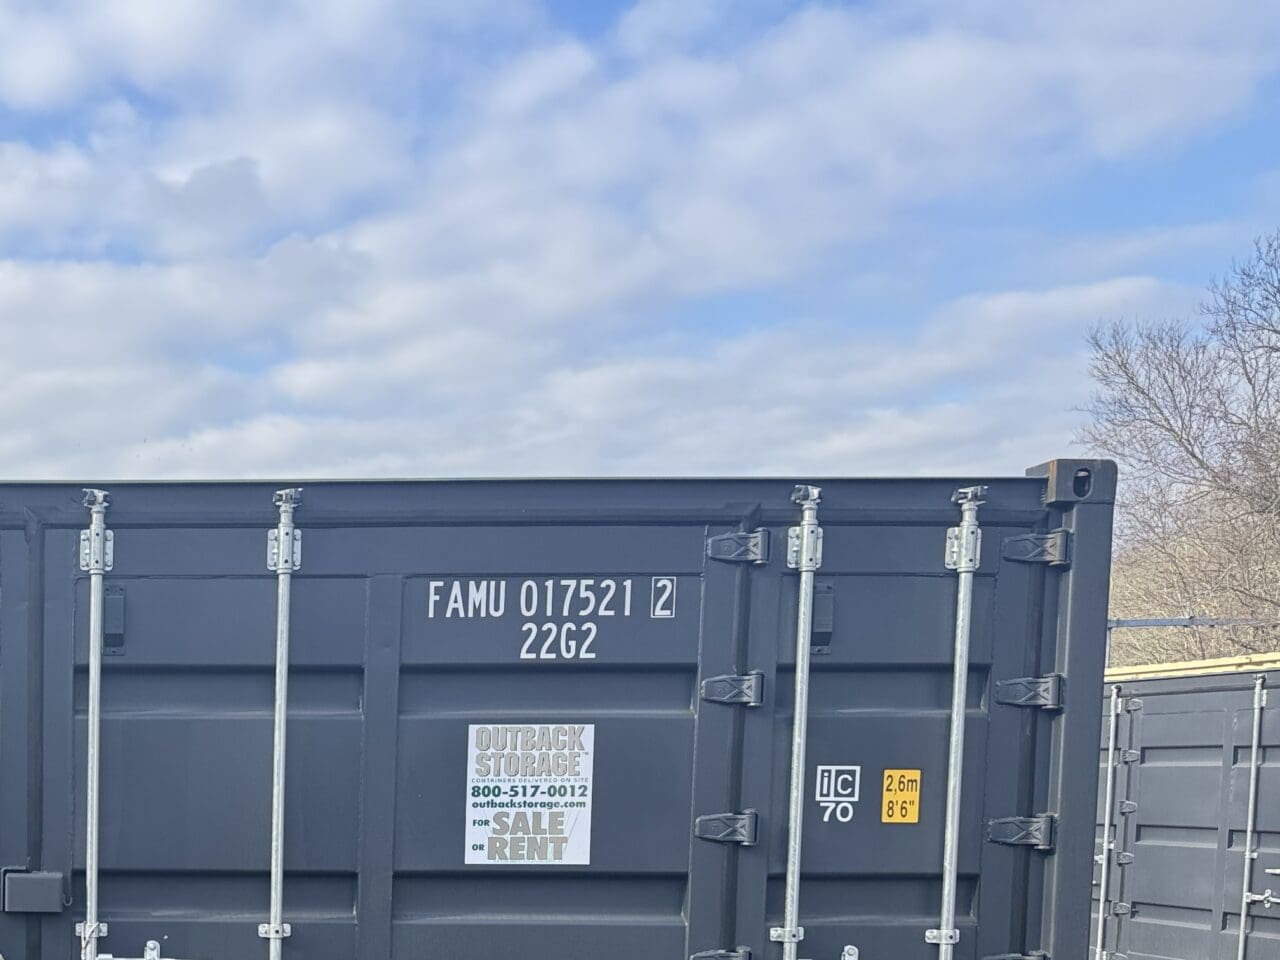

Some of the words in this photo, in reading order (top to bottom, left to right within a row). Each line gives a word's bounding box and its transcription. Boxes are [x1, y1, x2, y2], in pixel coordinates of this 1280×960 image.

[428, 580, 506, 618] FAMU
[520, 579, 632, 617] 017521
[654, 579, 673, 617] 2
[520, 622, 598, 659] 22G2
[475, 726, 585, 751] OUTBACK
[475, 751, 581, 777] STORAGE
[471, 785, 588, 798] 800-517-0012
[885, 774, 918, 795] 2,6m
[472, 799, 586, 809] outbackstorage.com
[820, 802, 854, 822] 70
[887, 800, 915, 818] 8'6"
[472, 819, 490, 827] FOR
[492, 811, 565, 836] SALE
[472, 843, 485, 851] OR
[487, 836, 568, 861] RENT
